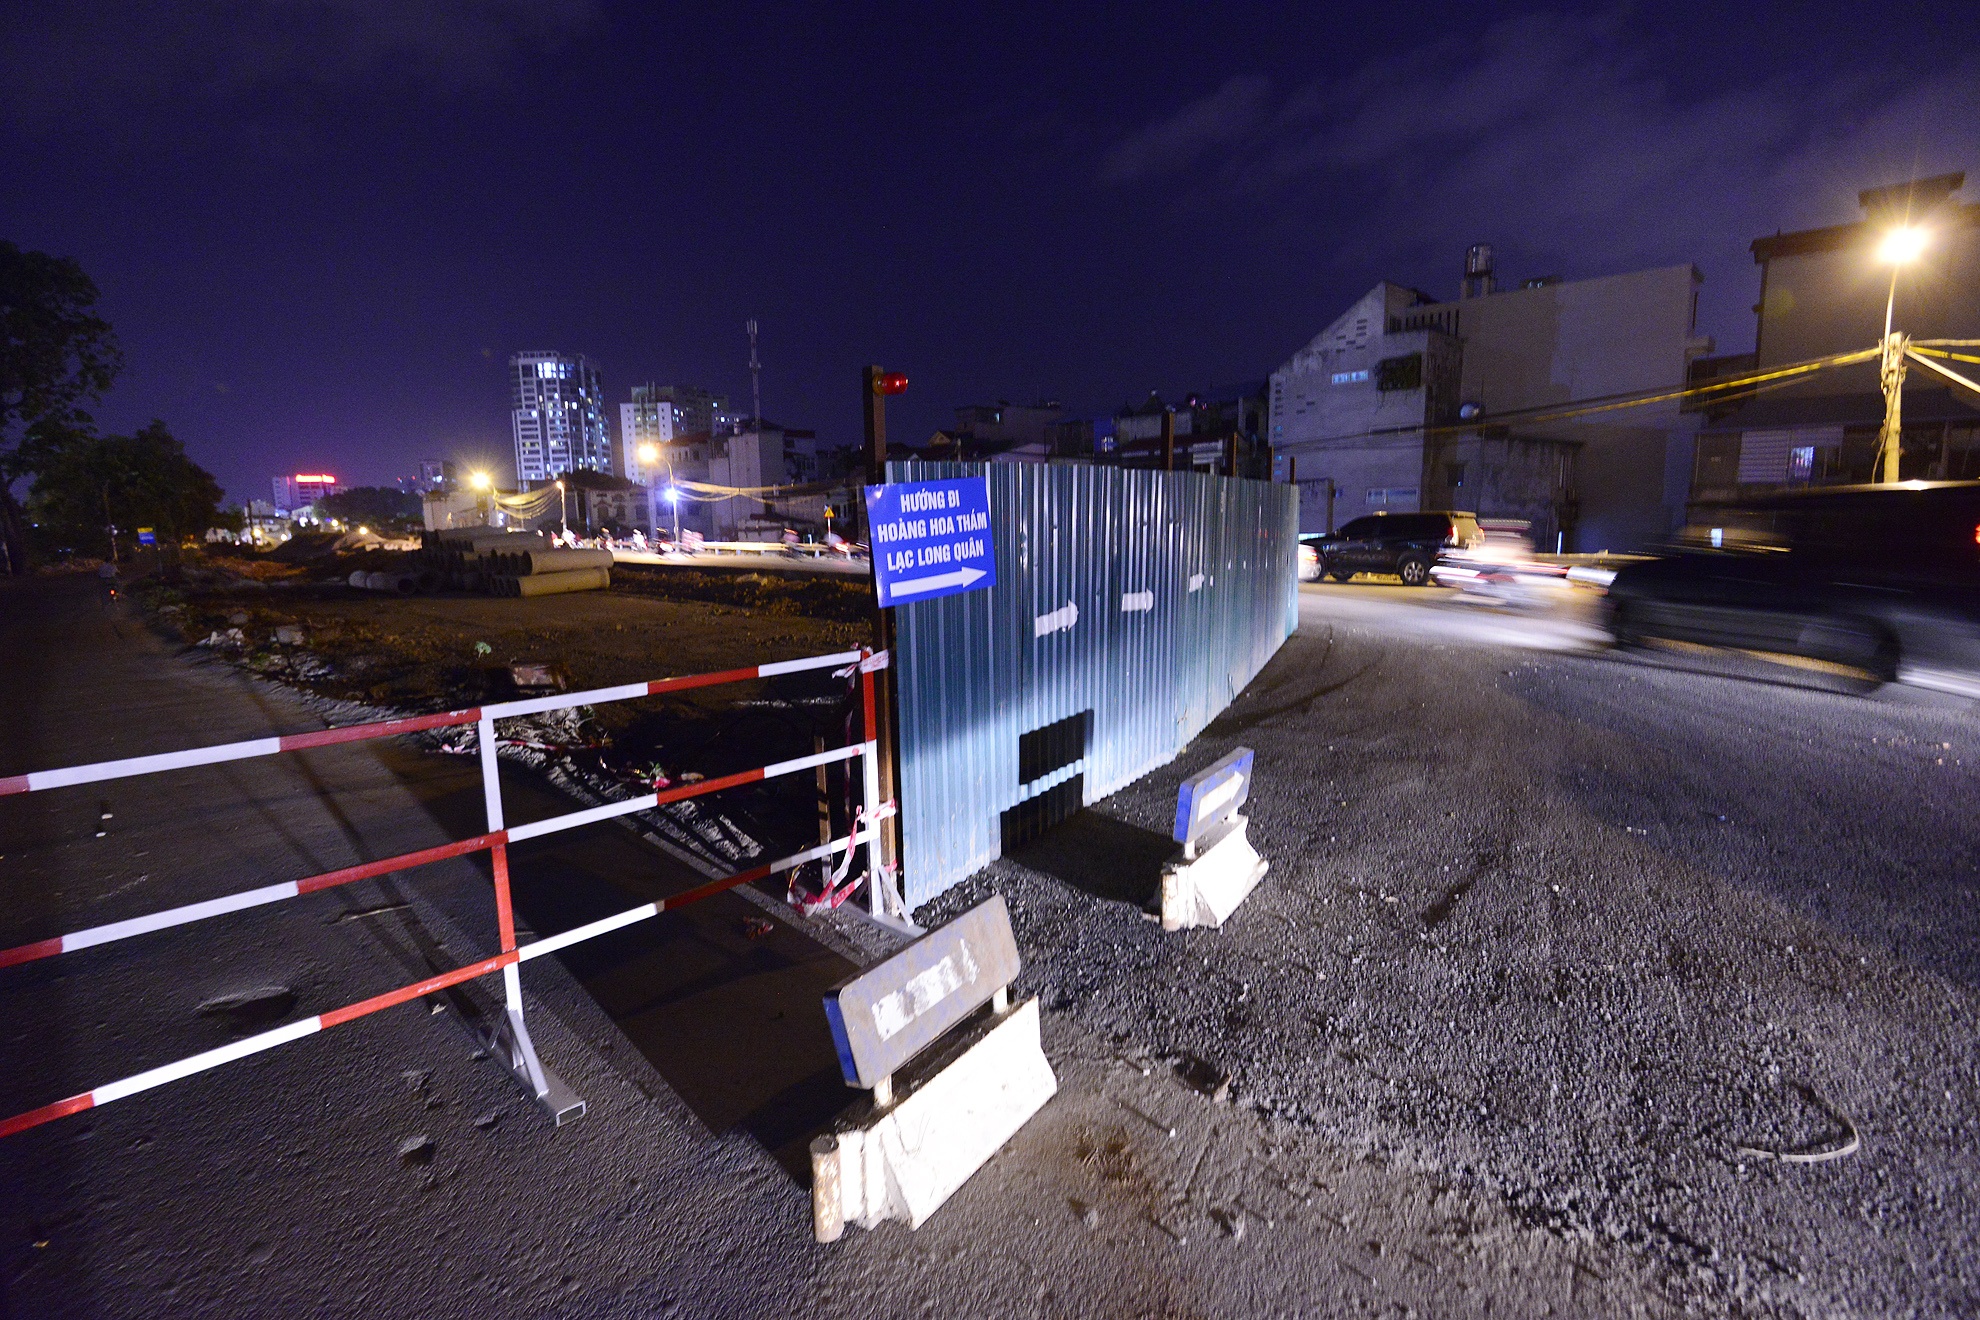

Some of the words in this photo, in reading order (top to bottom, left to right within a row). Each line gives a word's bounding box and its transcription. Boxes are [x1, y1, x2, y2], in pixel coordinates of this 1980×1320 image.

[900, 488, 945, 513] HƯỚNG
[947, 489, 960, 508] ĐI
[877, 518, 927, 543] HOÀNG
[929, 516, 955, 537] HOA
[956, 508, 988, 533] THÁM
[886, 549, 914, 574] LẠC
[917, 544, 951, 567] LONG
[953, 536, 985, 562] QUÂN
